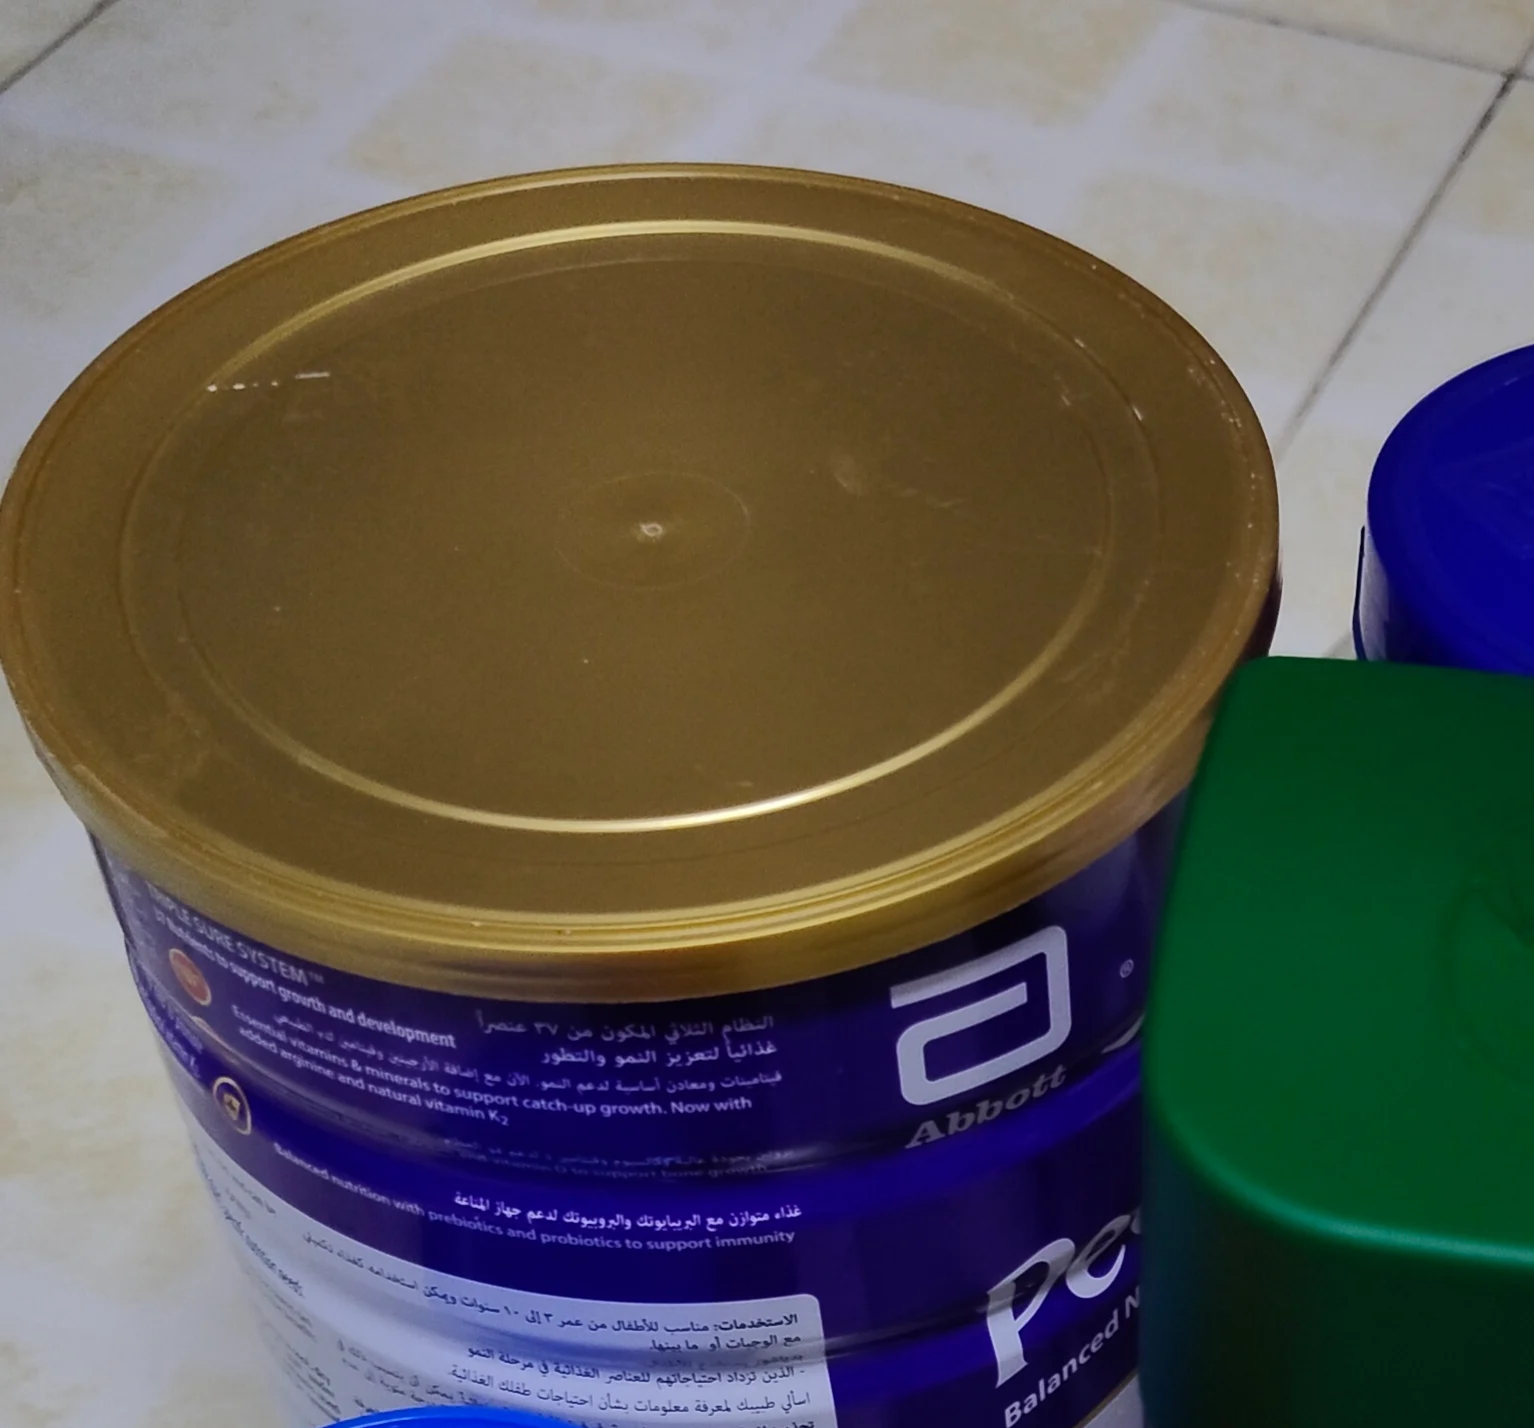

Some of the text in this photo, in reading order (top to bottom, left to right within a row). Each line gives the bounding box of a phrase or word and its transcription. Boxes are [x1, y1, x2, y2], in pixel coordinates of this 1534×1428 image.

[279, 985, 327, 1016] growth
[329, 1002, 355, 1024] and
[357, 1013, 457, 1049] development
[534, 1021, 559, 1037] ٣٧
[567, 1025, 593, 1041] من
[600, 1024, 656, 1043] المكون
[720, 1015, 775, 1044] النظام
[541, 1046, 607, 1069] والتطور
[613, 1048, 657, 1069] النمو
[665, 1045, 720, 1068] لتعزيز
[239, 1024, 278, 1055] added
[337, 1072, 366, 1092] and
[367, 1081, 423, 1108] natural
[424, 1096, 487, 1120] vitamin
[288, 1036, 350, 1068] vitamins
[365, 1063, 431, 1092] minerals
[432, 1081, 450, 1097] to
[453, 1084, 520, 1108] support
[521, 1095, 596, 1117] catch-up
[599, 1100, 668, 1119] growth.
[671, 1101, 712, 1115] Now
[714, 1095, 753, 1113] with
[484, 1071, 502, 1087] مع
[576, 1079, 610, 1094] لدعم
[666, 1077, 716, 1094] ومعادن
[905, 1064, 1068, 1149] Abbott
[452, 1190, 491, 1213] المناعة
[494, 1200, 523, 1220] جهاز
[330, 1173, 796, 1253] nutrition with prebiotics and probiotics to support immunity
[526, 1207, 559, 1225] لدعم
[728, 1210, 770, 1228] متوازن
[773, 1203, 804, 1220] غذاء
[705, 1214, 725, 1232] مع
[459, 1296, 501, 1315] سنوات
[525, 1311, 542, 1326] إلى
[559, 1317, 584, 1330] عمر
[588, 1320, 607, 1332] من
[612, 1318, 659, 1333] للأطفال
[664, 1320, 709, 1333] مناسب
[684, 1333, 802, 1352] مع الوجبات أو ما
[467, 1344, 495, 1360] النمو
[499, 1350, 535, 1371] مرحلة
[537, 1361, 550, 1376] في
[554, 1361, 599, 1380] الغذائية
[607, 1370, 651, 1385] للعناصر
[763, 1366, 795, 1385] الذين
[727, 1370, 757, 1386] تزداد
[497, 1378, 811, 1416] اسألي طبيبك لمعرفة معلومات بشأن احتياجات طفلك
